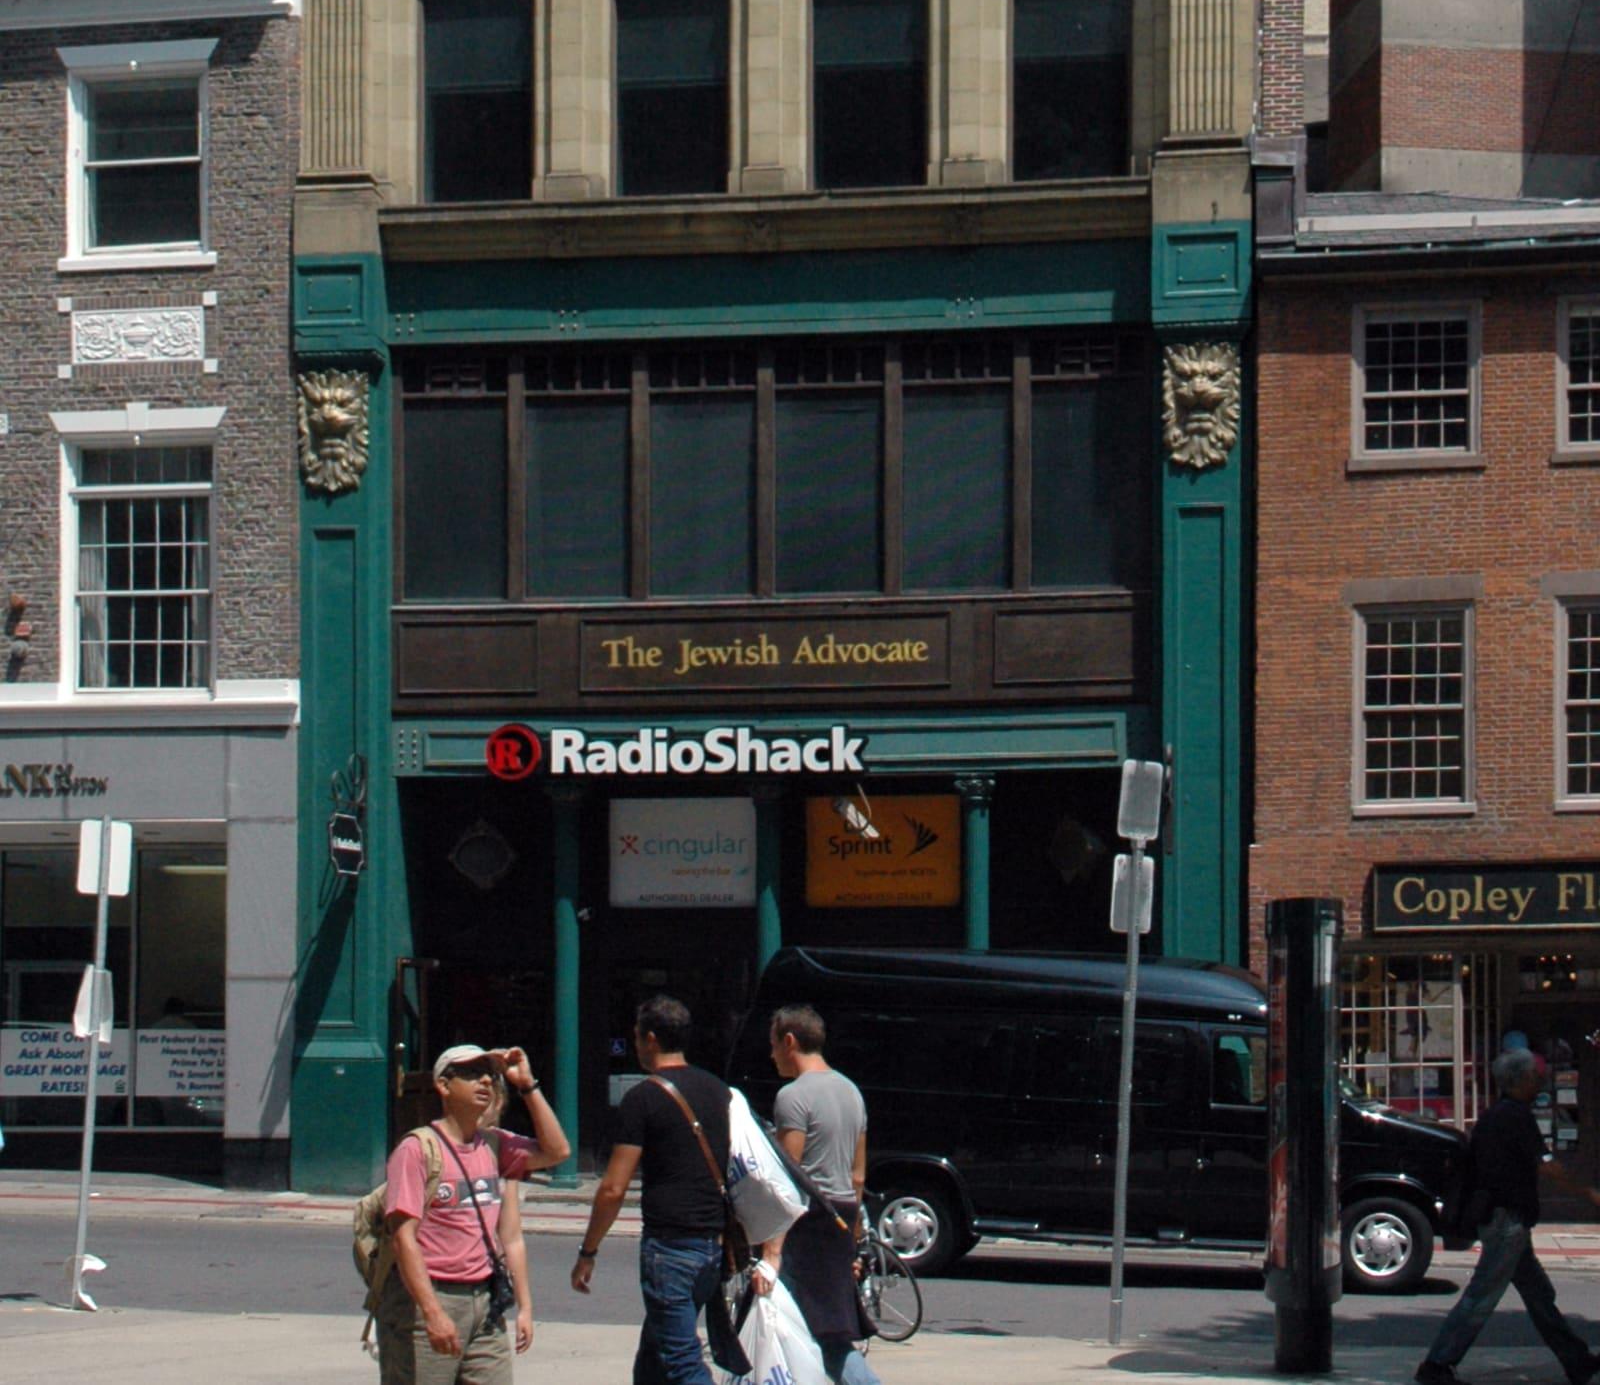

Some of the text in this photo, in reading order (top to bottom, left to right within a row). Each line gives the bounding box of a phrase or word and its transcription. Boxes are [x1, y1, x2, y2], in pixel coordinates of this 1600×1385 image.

[601, 634, 929, 675] The Jewish Advocate
[550, 725, 864, 774] RadioShack
[0, 764, 53, 798] NK
[643, 830, 747, 862] cingular
[828, 835, 892, 860] Sprint
[1393, 872, 1600, 922] Copley Fl
[20, 1031, 60, 1043] COME
[4, 1064, 127, 1076] GREAT MORTAGE
[46, 1048, 85, 1060] About
